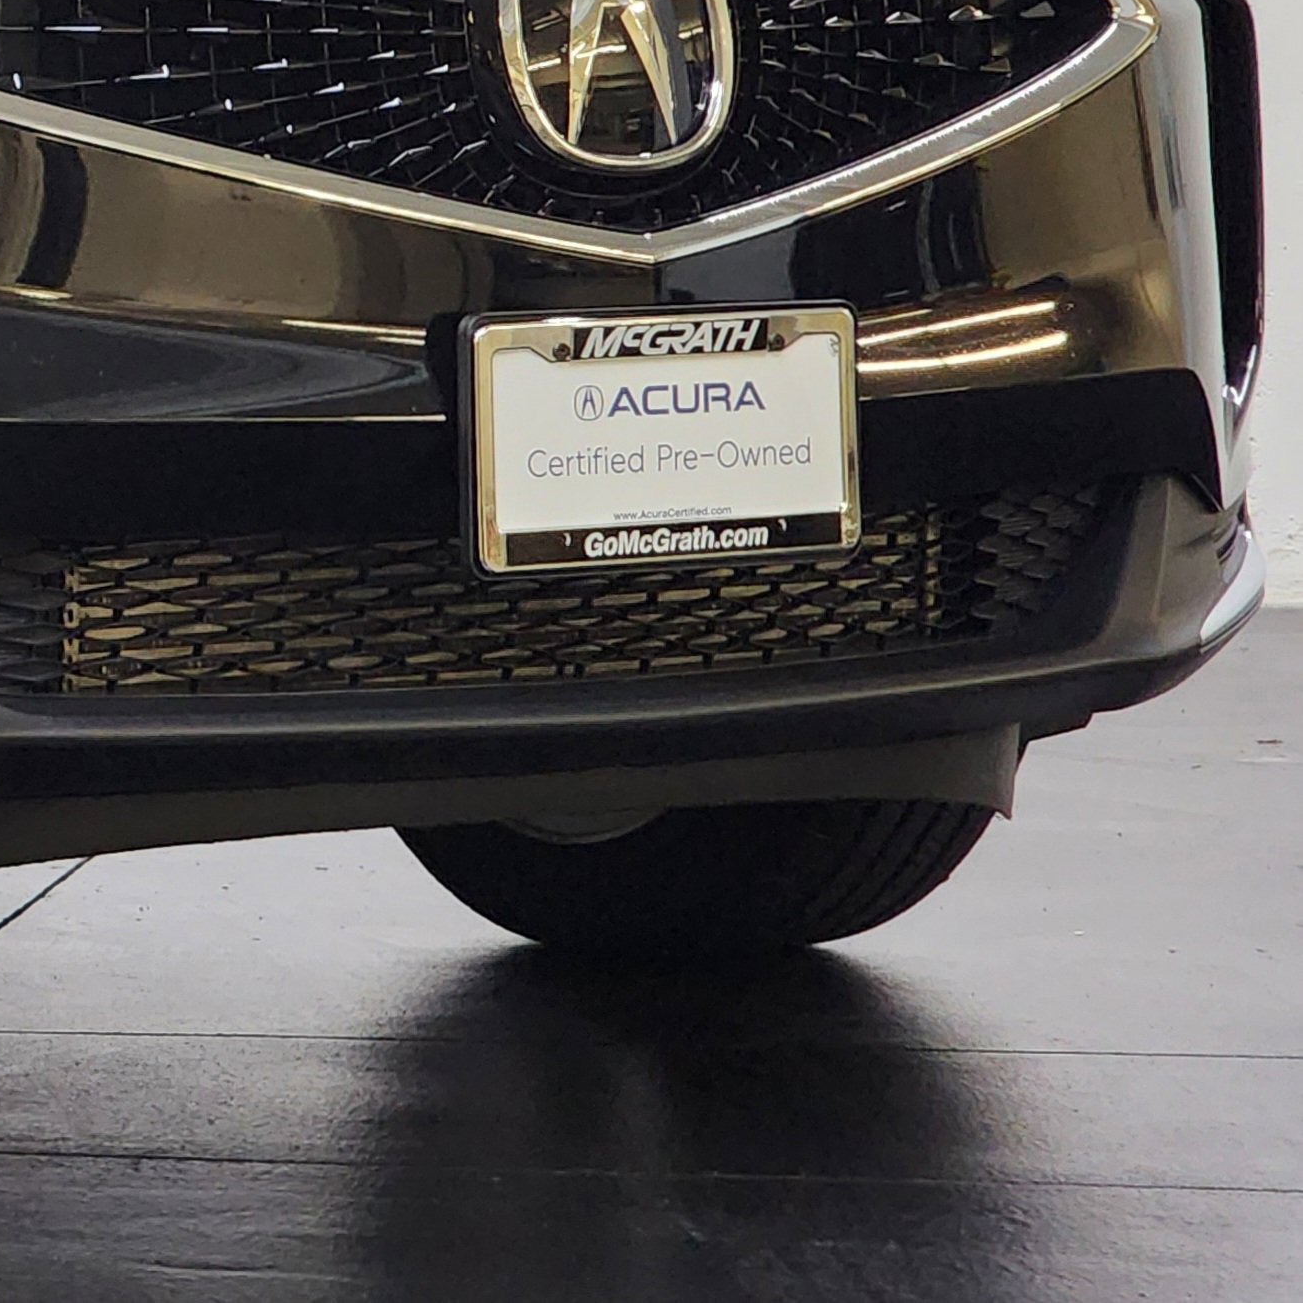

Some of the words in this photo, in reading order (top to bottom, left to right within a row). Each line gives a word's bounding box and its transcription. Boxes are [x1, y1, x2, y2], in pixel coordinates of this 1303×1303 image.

[581, 320, 760, 358] McGRATH
[607, 381, 766, 417] ACURA
[527, 446, 645, 478] Certified
[656, 437, 812, 473] Pre-Owned
[613, 505, 732, 521] www.AcuraCertified.com
[583, 524, 769, 558] GoMcGrath.com
